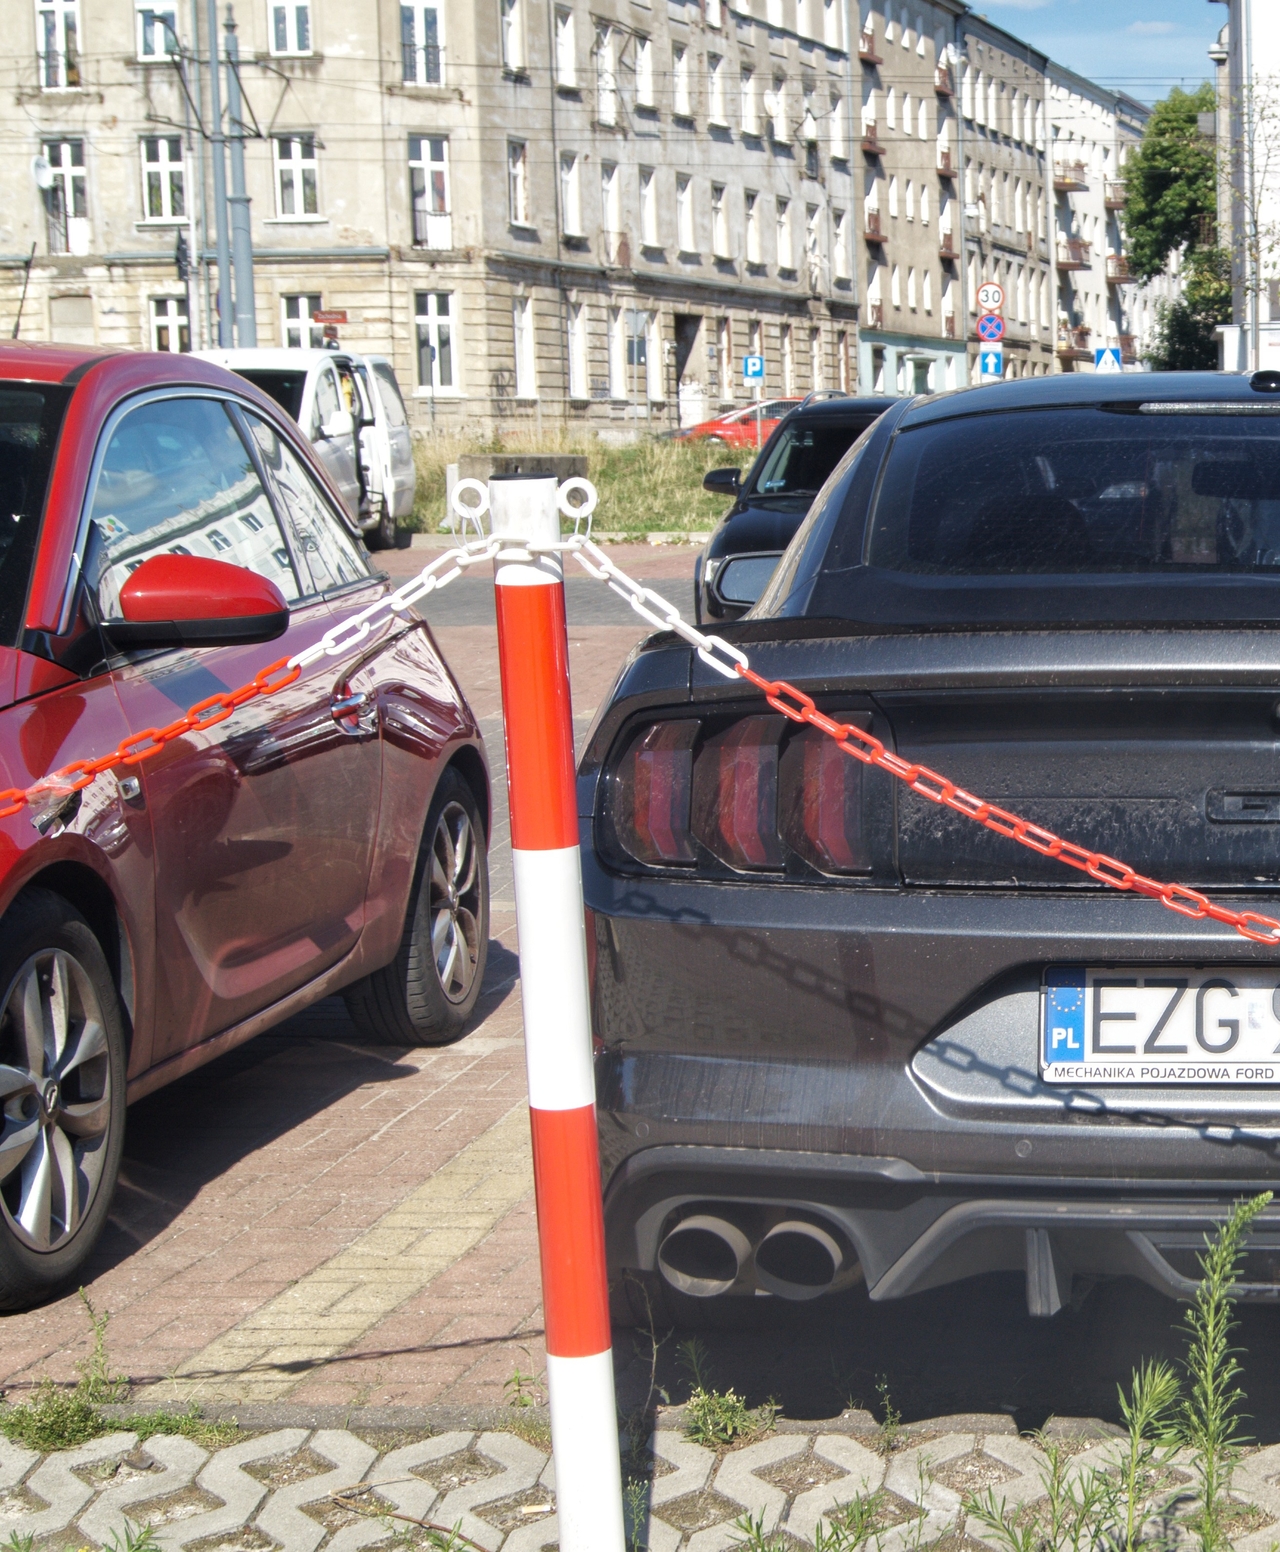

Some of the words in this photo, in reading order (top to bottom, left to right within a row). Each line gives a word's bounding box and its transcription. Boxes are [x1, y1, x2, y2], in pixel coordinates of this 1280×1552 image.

[980, 289, 1001, 303] 30
[747, 357, 761, 376] P
[1092, 978, 1240, 1054] EZG
[1052, 1028, 1080, 1048] PL
[1054, 1066, 1136, 1079] MECHANIKA
[1140, 1067, 1231, 1079] POJAZDOWA
[1235, 1067, 1274, 1079] FORD
